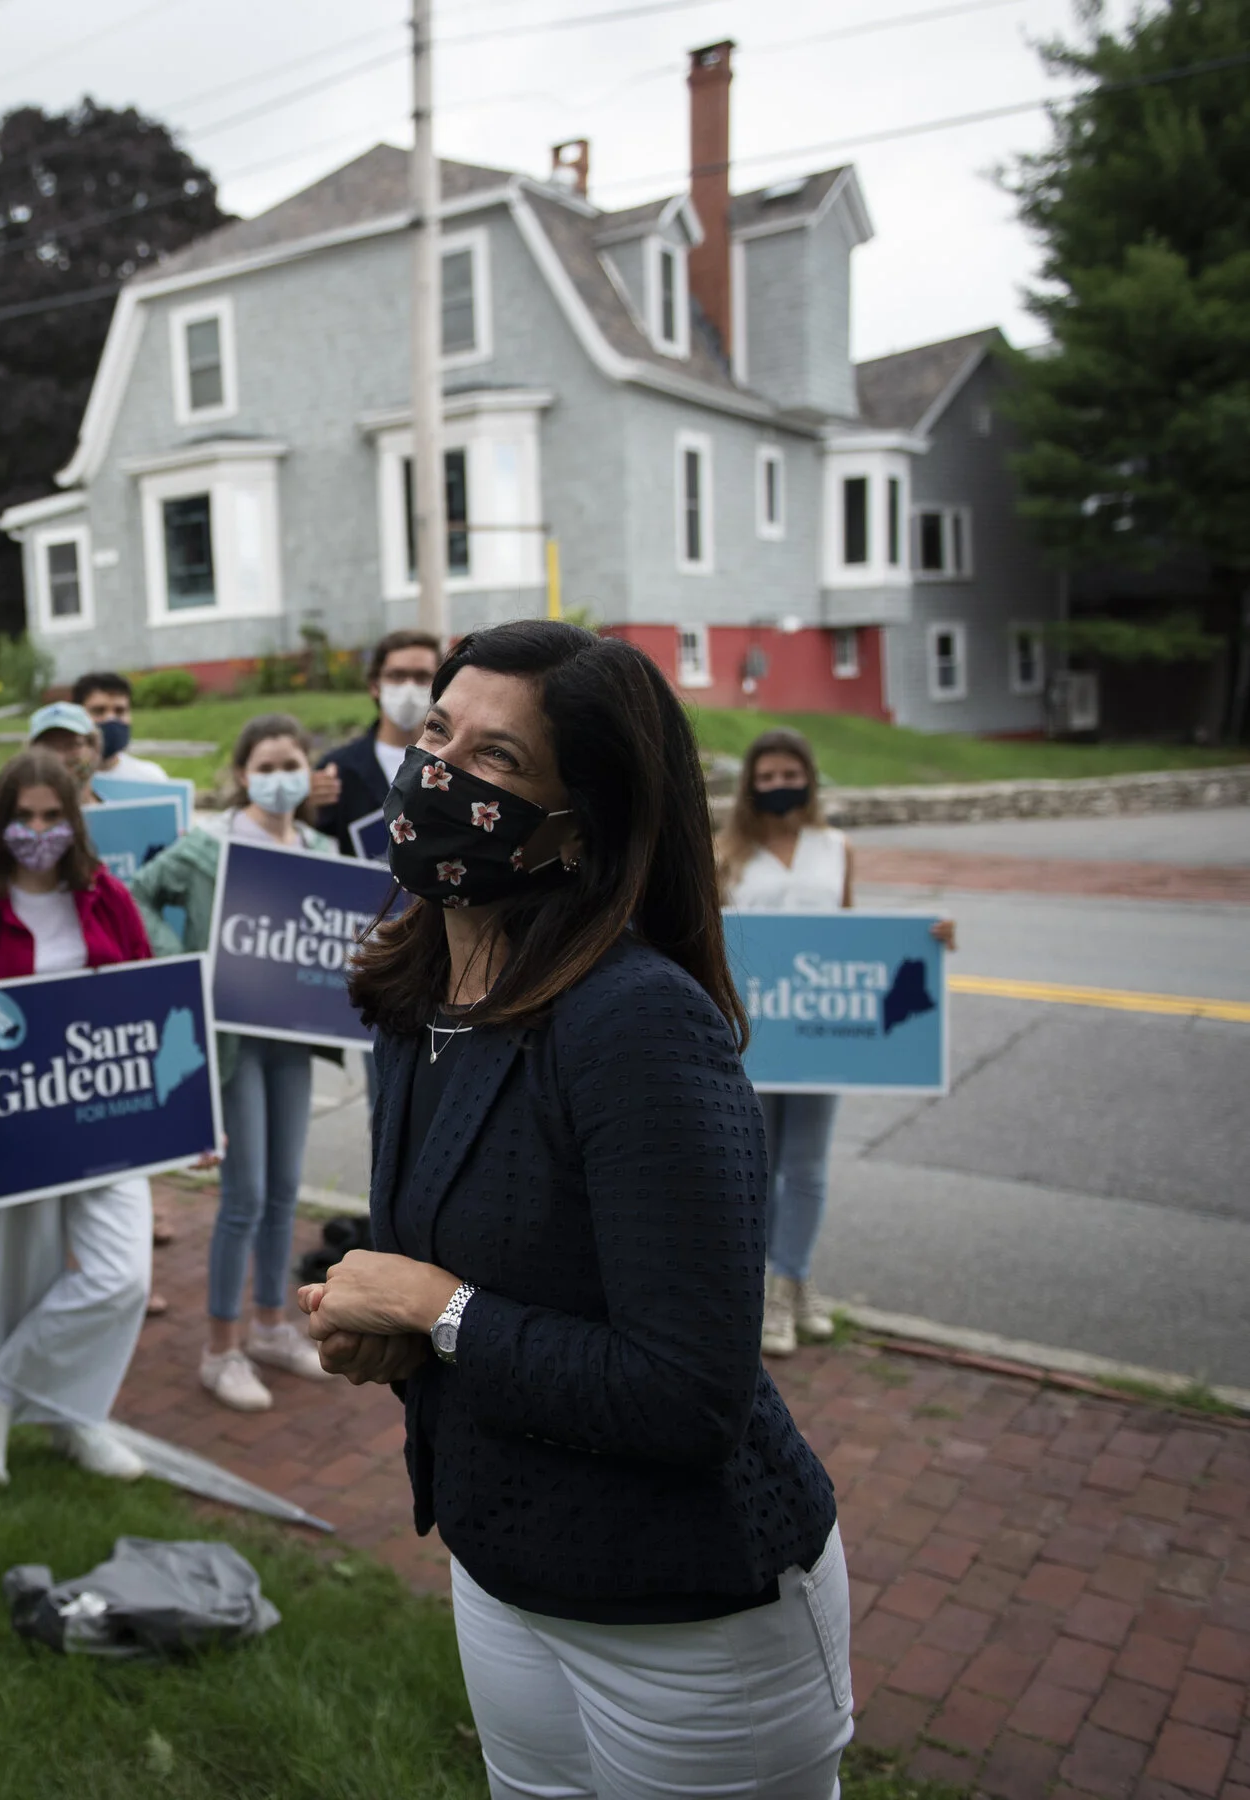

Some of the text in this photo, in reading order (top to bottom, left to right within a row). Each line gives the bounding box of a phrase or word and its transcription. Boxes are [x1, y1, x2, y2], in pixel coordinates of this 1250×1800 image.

[793, 951, 888, 988] Sara
[746, 976, 878, 1020] ideon
[65, 1020, 159, 1066] Sara
